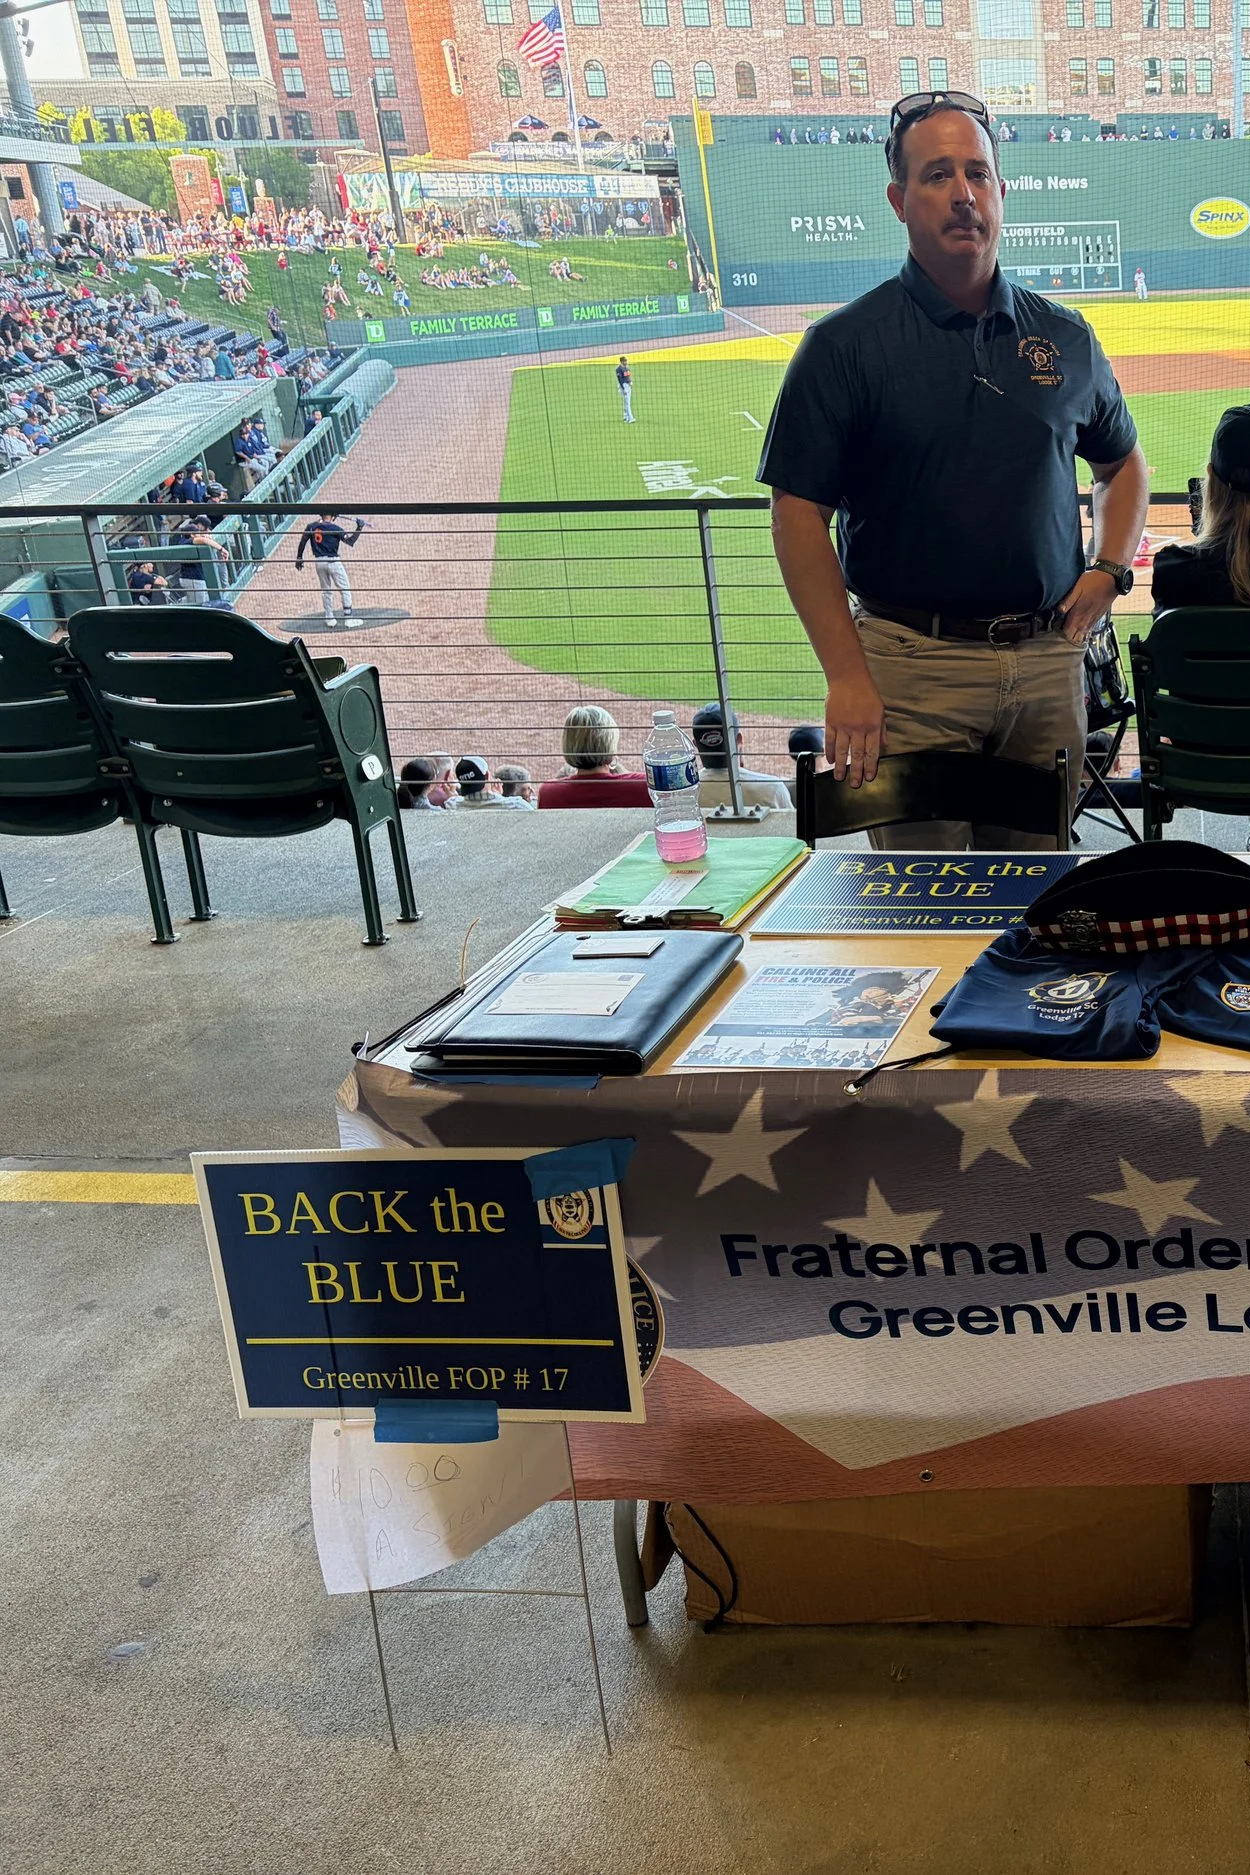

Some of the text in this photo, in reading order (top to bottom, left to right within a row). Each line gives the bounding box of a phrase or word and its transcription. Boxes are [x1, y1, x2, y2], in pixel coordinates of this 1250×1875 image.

[505, 176, 590, 195] CLUBHOUSE
[1047, 176, 1088, 190] News
[790, 215, 866, 232] PRISMA
[1197, 210, 1244, 223] SPINX
[1001, 227, 1065, 237] LUOR FIELD
[732, 272, 758, 287] 310
[572, 300, 660, 321] FAMILY TERRACE
[410, 312, 518, 336] FAMILY TERRACE
[836, 862, 1048, 877] BACK the
[858, 882, 995, 897] BLUE
[948, 915, 1004, 925] FOP
[1008, 915, 1024, 924] #
[762, 968, 857, 977] CALLING ALL
[802, 976, 855, 984] POLICE
[1027, 1001, 1099, 1014] Greenville SC
[1039, 1011, 1085, 1022] Lodge 17
[237, 1189, 420, 1235] BACK
[430, 1188, 506, 1233] the
[720, 1232, 1048, 1278] Fraternal
[301, 1261, 465, 1304] BLUE
[828, 1291, 1188, 1339] Greenville
[303, 1365, 568, 1391] Greenville FOP # 17
